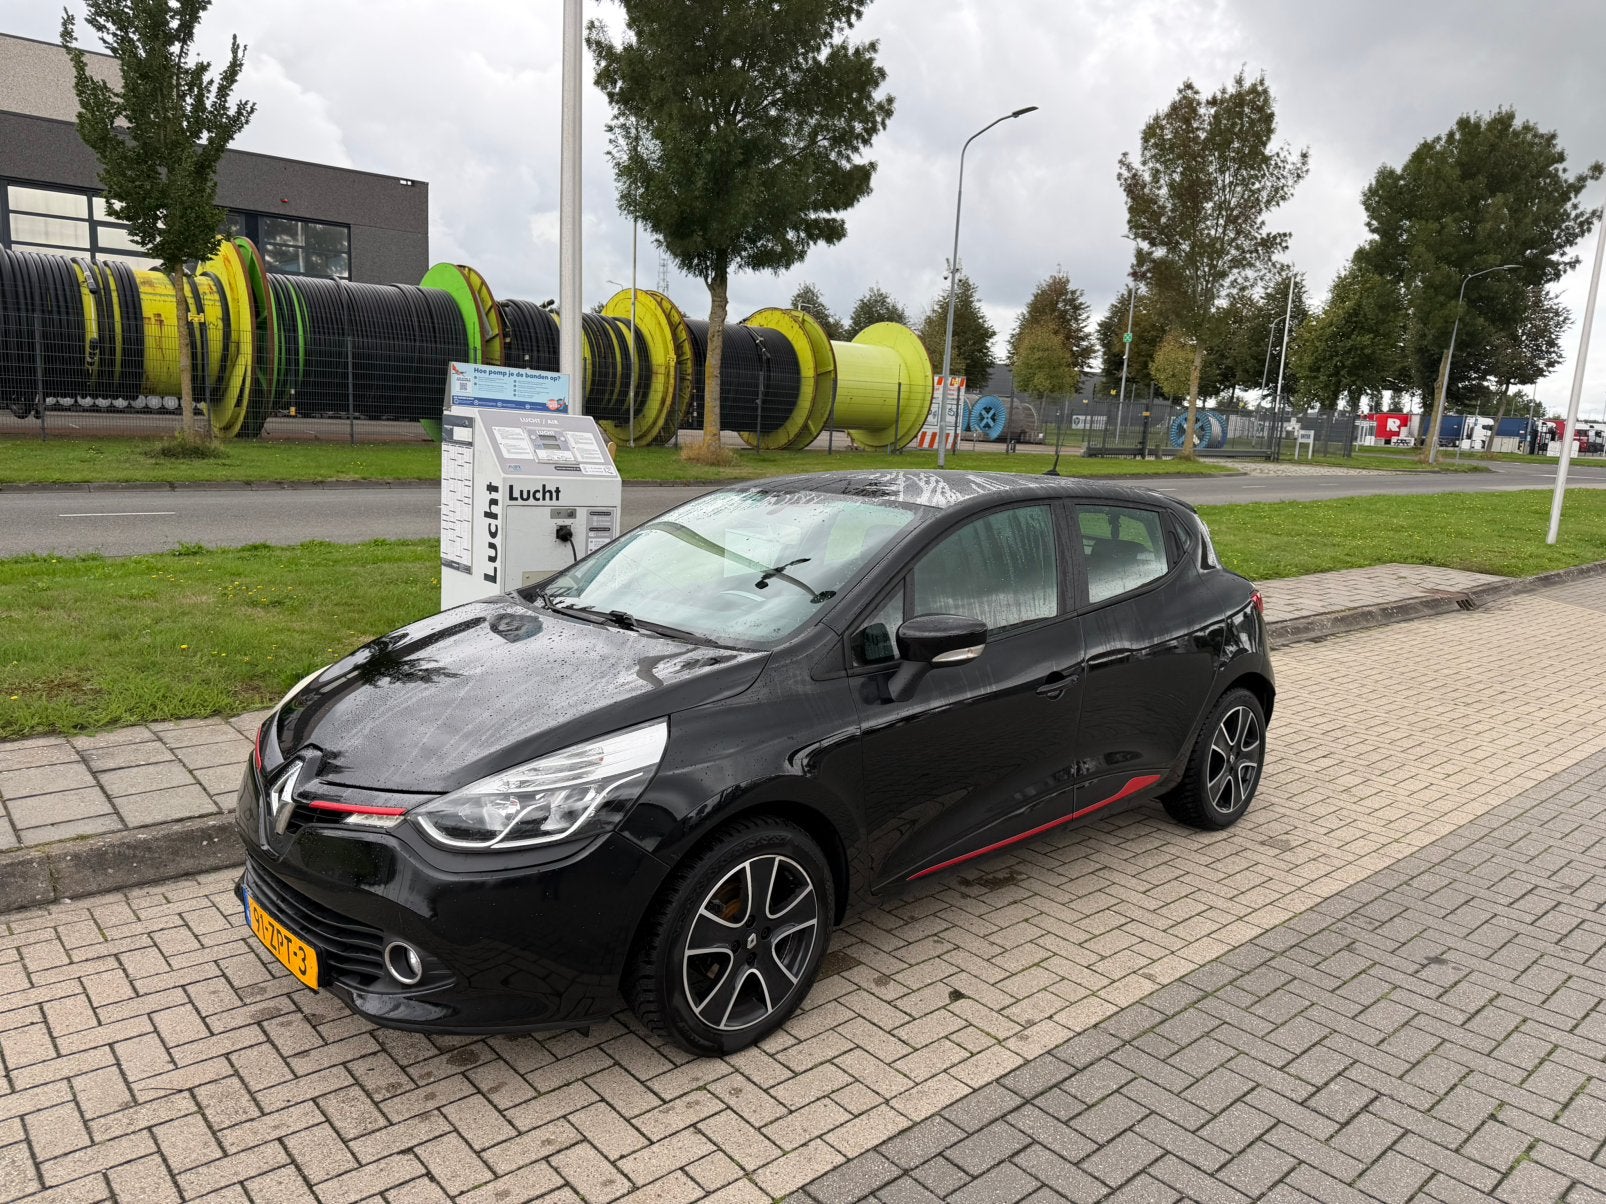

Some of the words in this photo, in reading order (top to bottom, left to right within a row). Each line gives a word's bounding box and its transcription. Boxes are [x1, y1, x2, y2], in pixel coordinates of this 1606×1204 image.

[525, 372, 549, 380] banden
[509, 484, 561, 501] Lucht
[484, 482, 499, 584] Lucht
[254, 906, 307, 976] 91-ZPT-3
